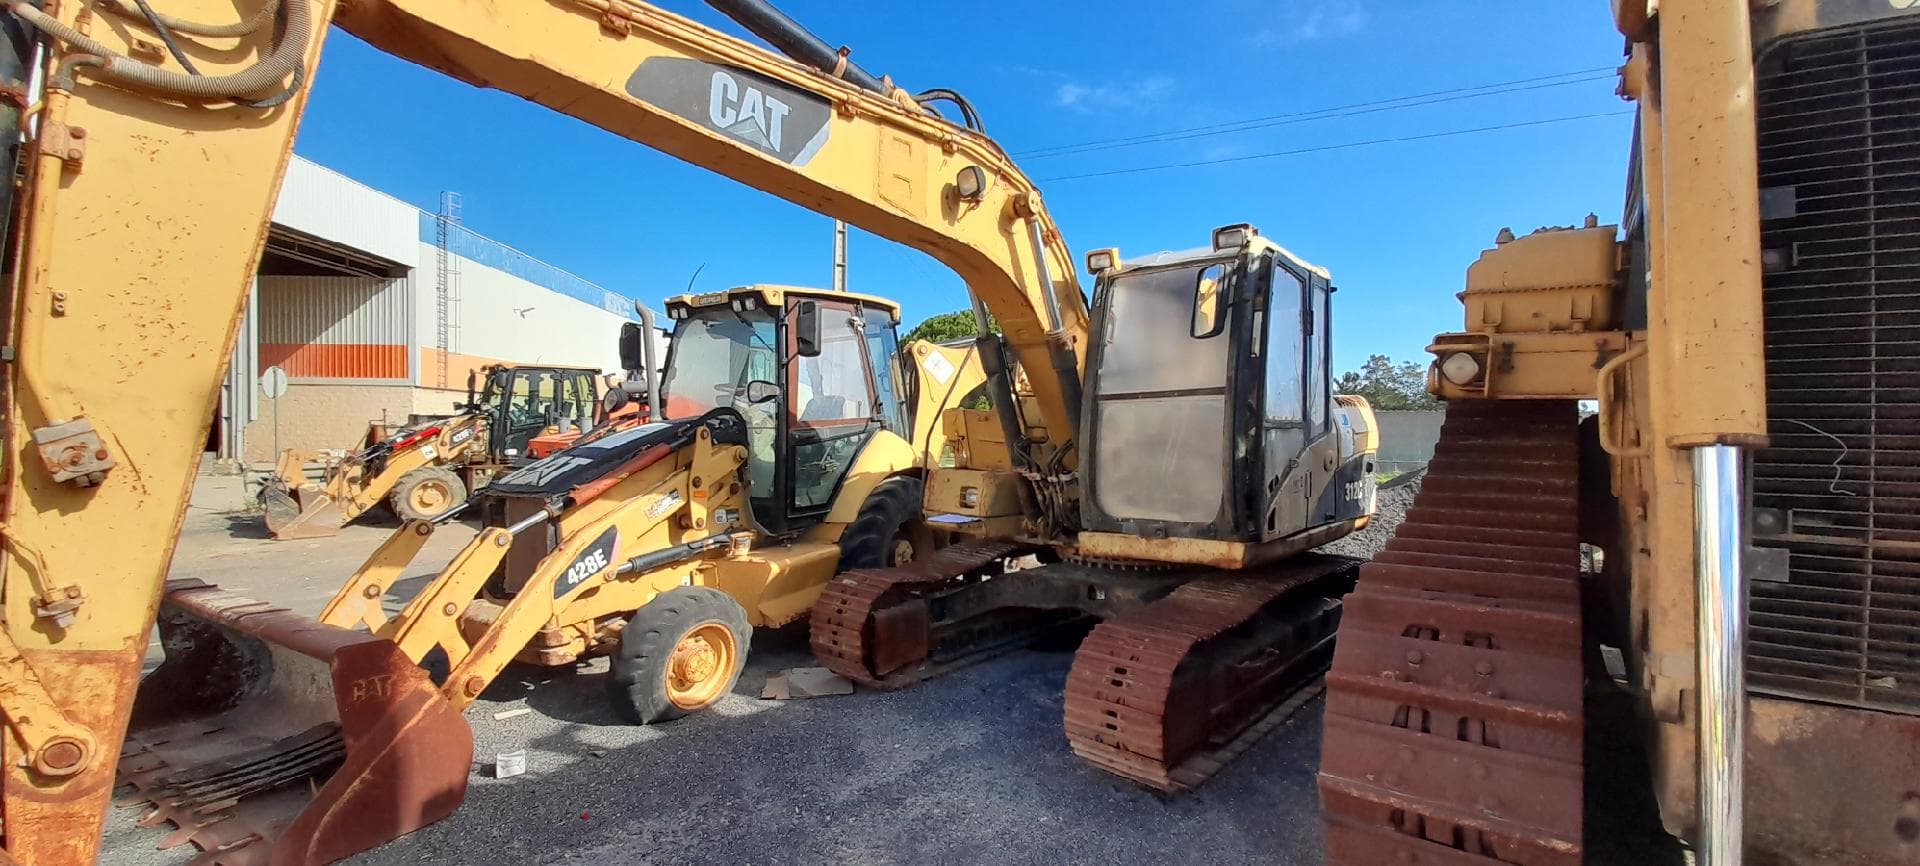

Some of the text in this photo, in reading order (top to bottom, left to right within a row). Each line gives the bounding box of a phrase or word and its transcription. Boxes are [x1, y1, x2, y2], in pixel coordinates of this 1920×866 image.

[709, 71, 790, 153] CAT
[1344, 480, 1363, 502] 312C
[568, 548, 608, 585] 428E
